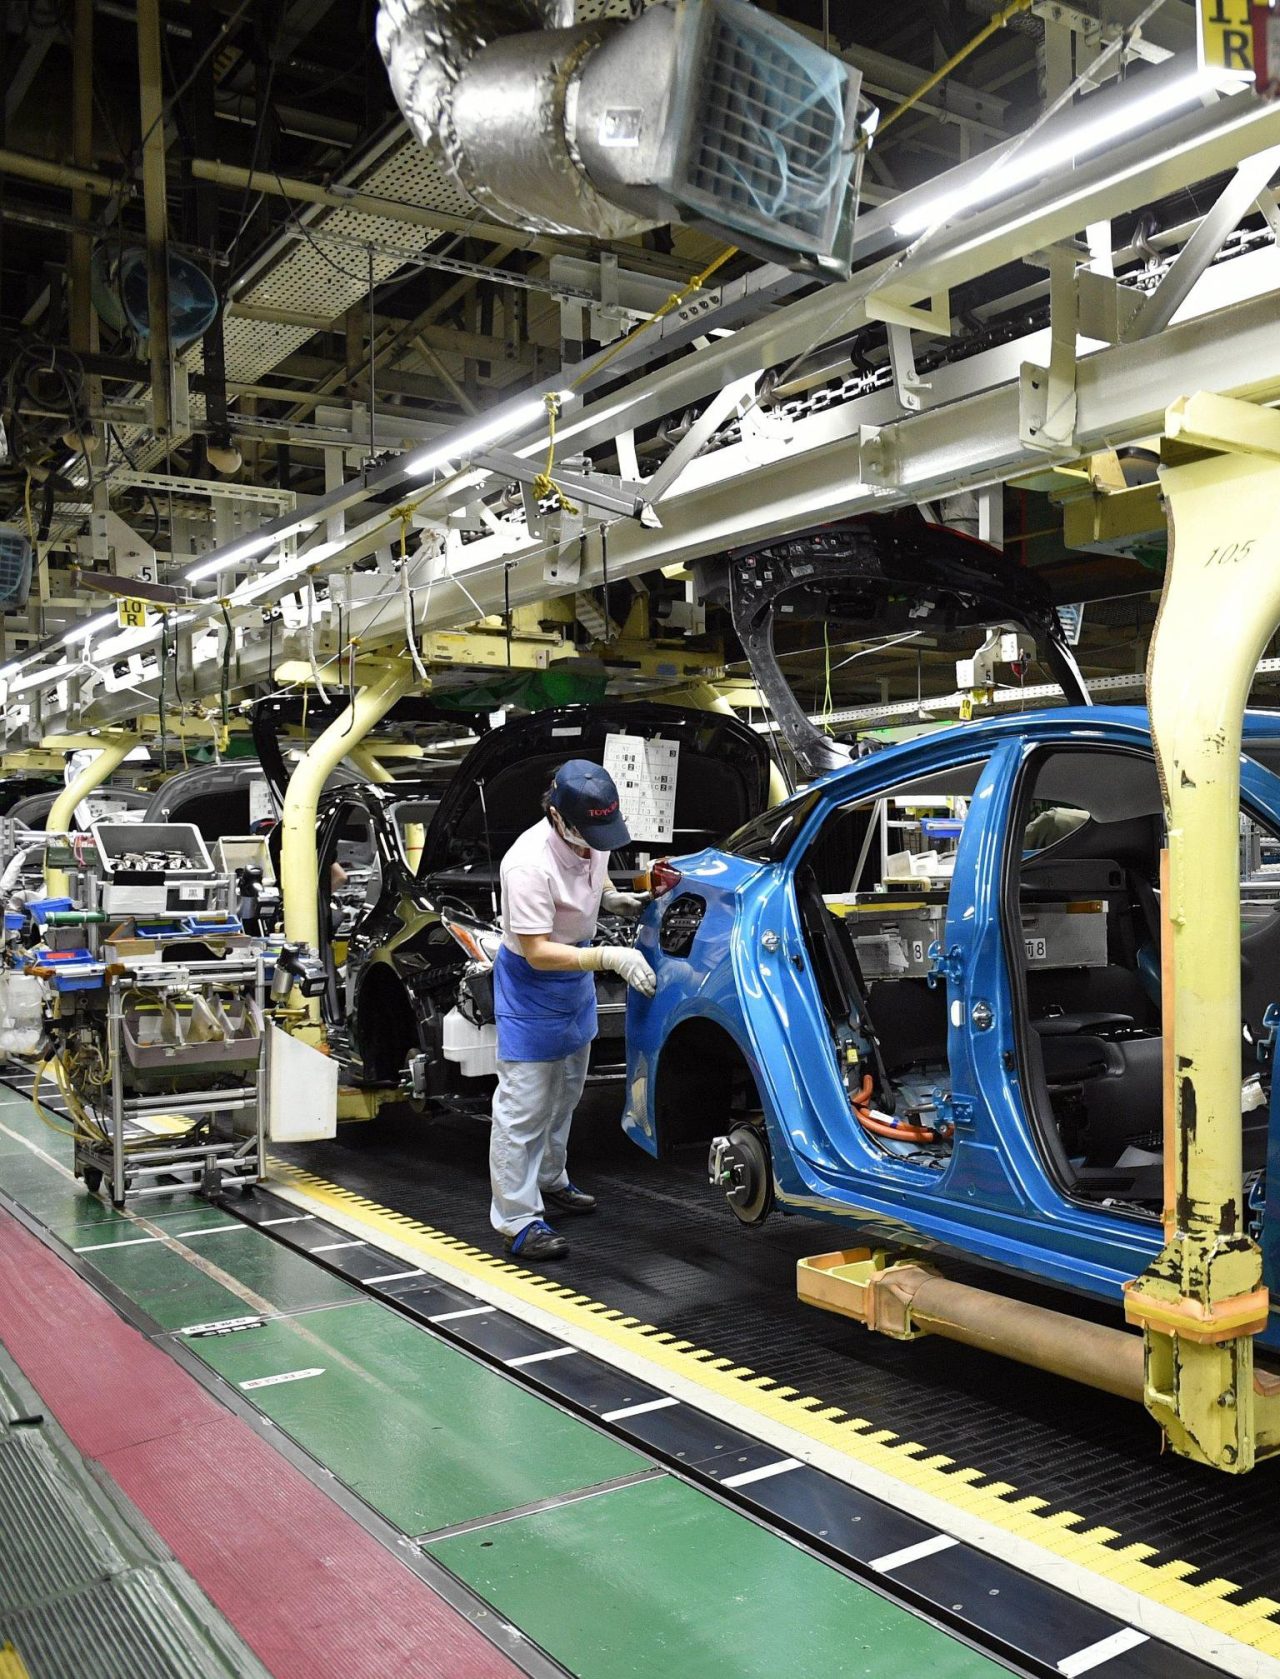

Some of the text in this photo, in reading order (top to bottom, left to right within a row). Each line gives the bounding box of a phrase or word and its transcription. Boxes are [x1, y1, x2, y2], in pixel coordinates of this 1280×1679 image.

[1223, 30, 1253, 69] R
[1204, 539, 1257, 569] 105
[142, 566, 152, 582] 5
[121, 600, 142, 613] 10
[127, 613, 138, 626] R
[914, 944, 921, 960] 8
